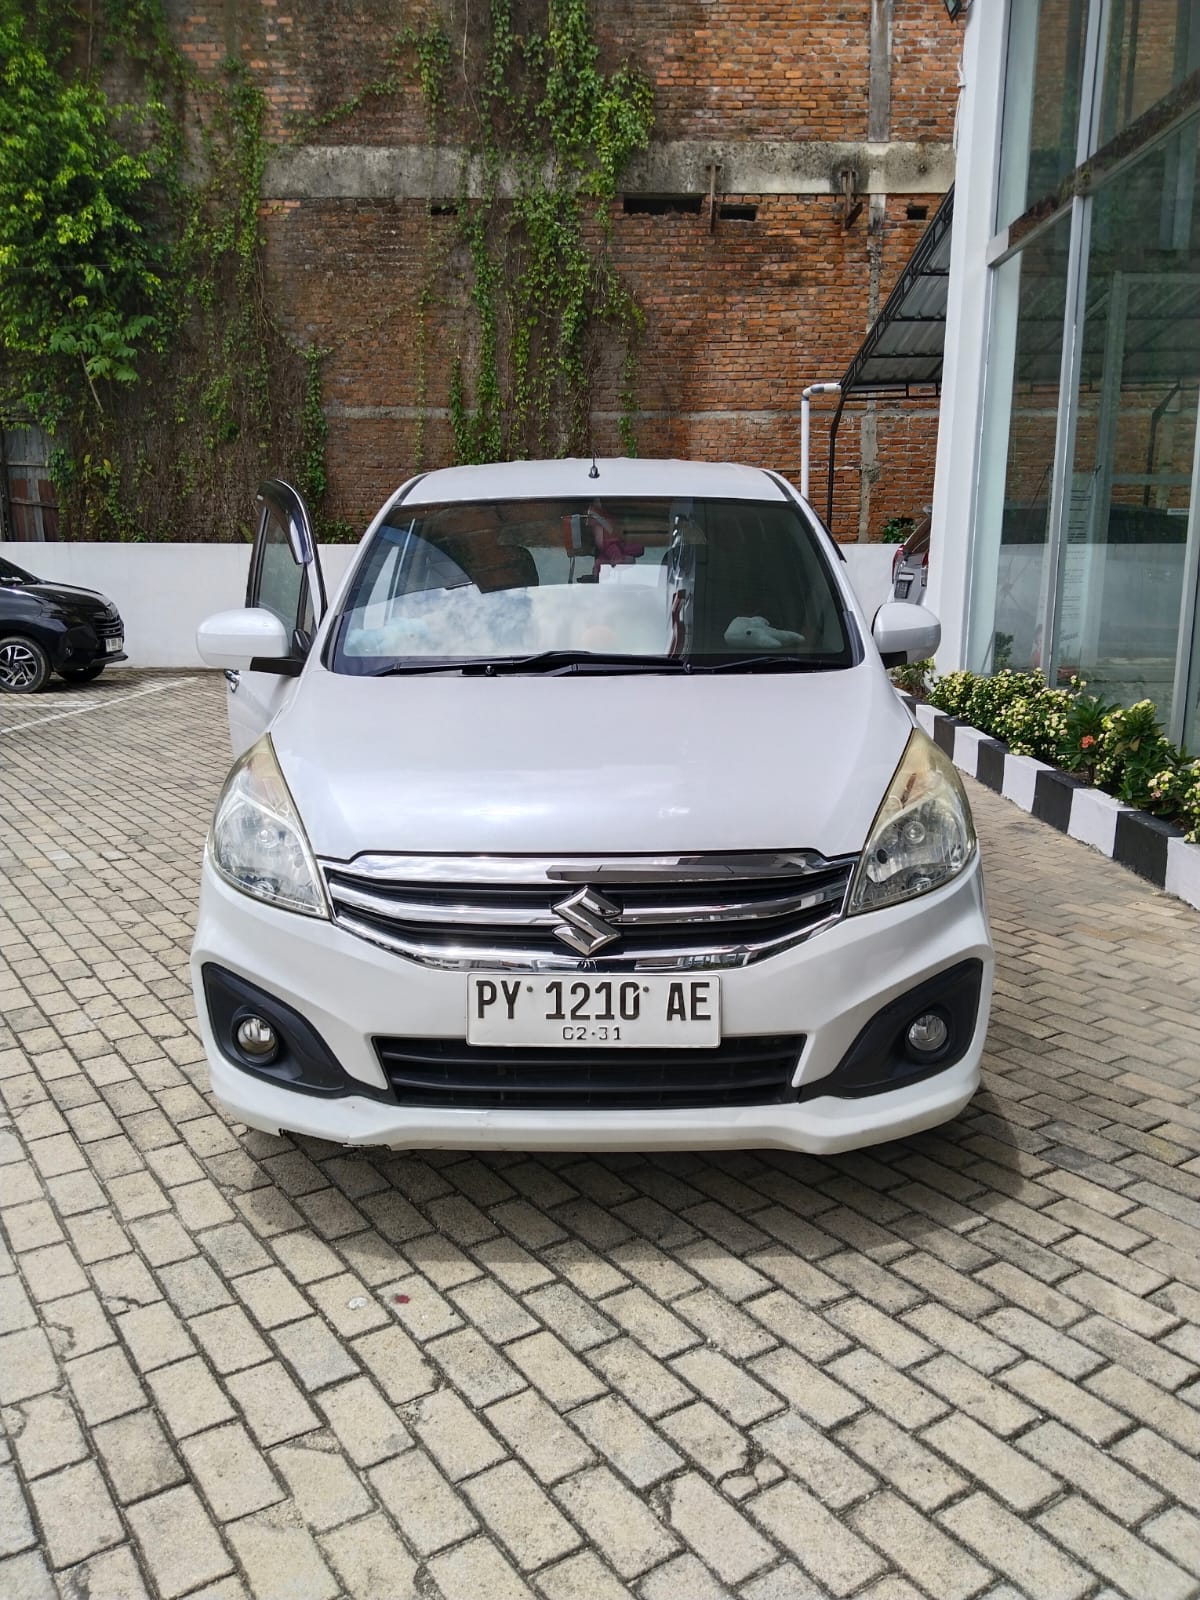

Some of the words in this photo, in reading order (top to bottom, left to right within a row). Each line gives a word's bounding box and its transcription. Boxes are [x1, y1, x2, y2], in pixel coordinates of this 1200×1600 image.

[475, 980, 521, 1019] PY
[545, 981, 640, 1021] 1210
[666, 982, 711, 1021] AE
